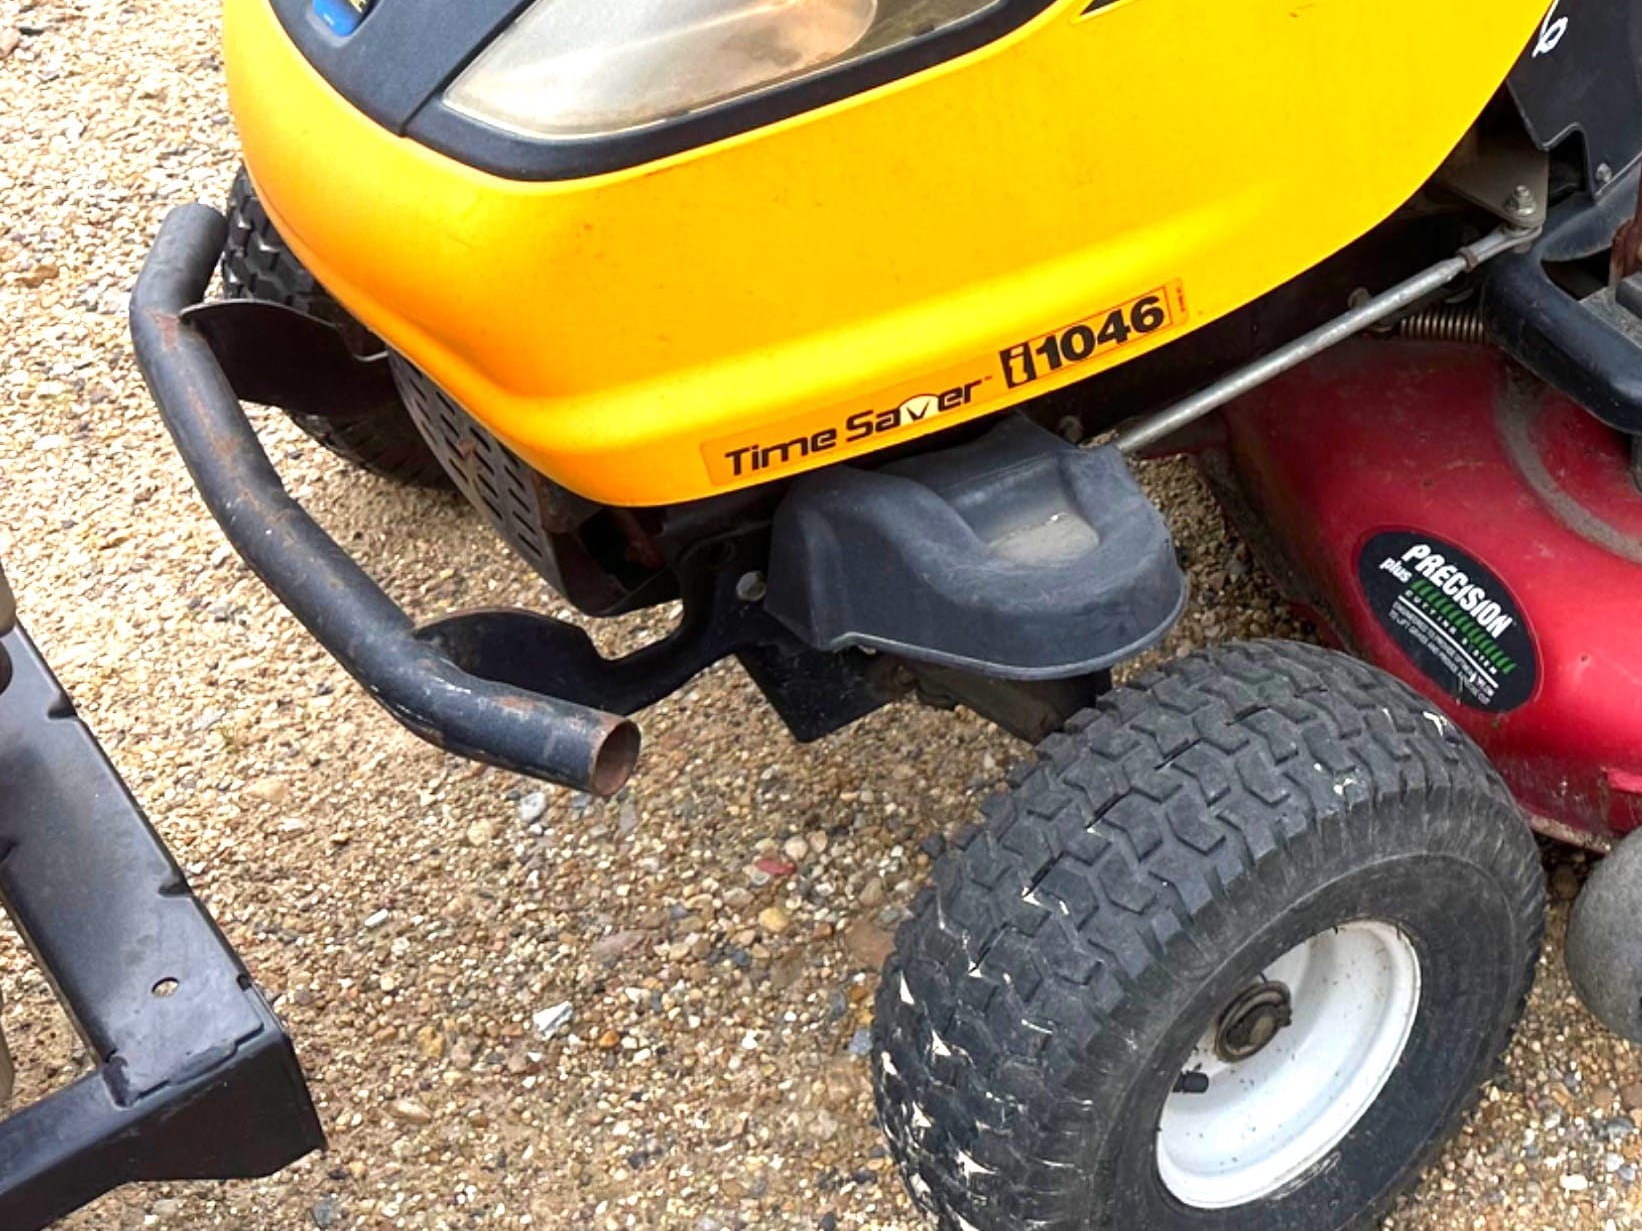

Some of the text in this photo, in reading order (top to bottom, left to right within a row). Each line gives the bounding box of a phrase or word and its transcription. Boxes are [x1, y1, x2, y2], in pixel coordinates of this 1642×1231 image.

[724, 379, 983, 476] Time Saver
[1379, 556, 1413, 584] plus
[1400, 543, 1514, 640] PRECISION
[1461, 636, 1498, 675] SSTEM
